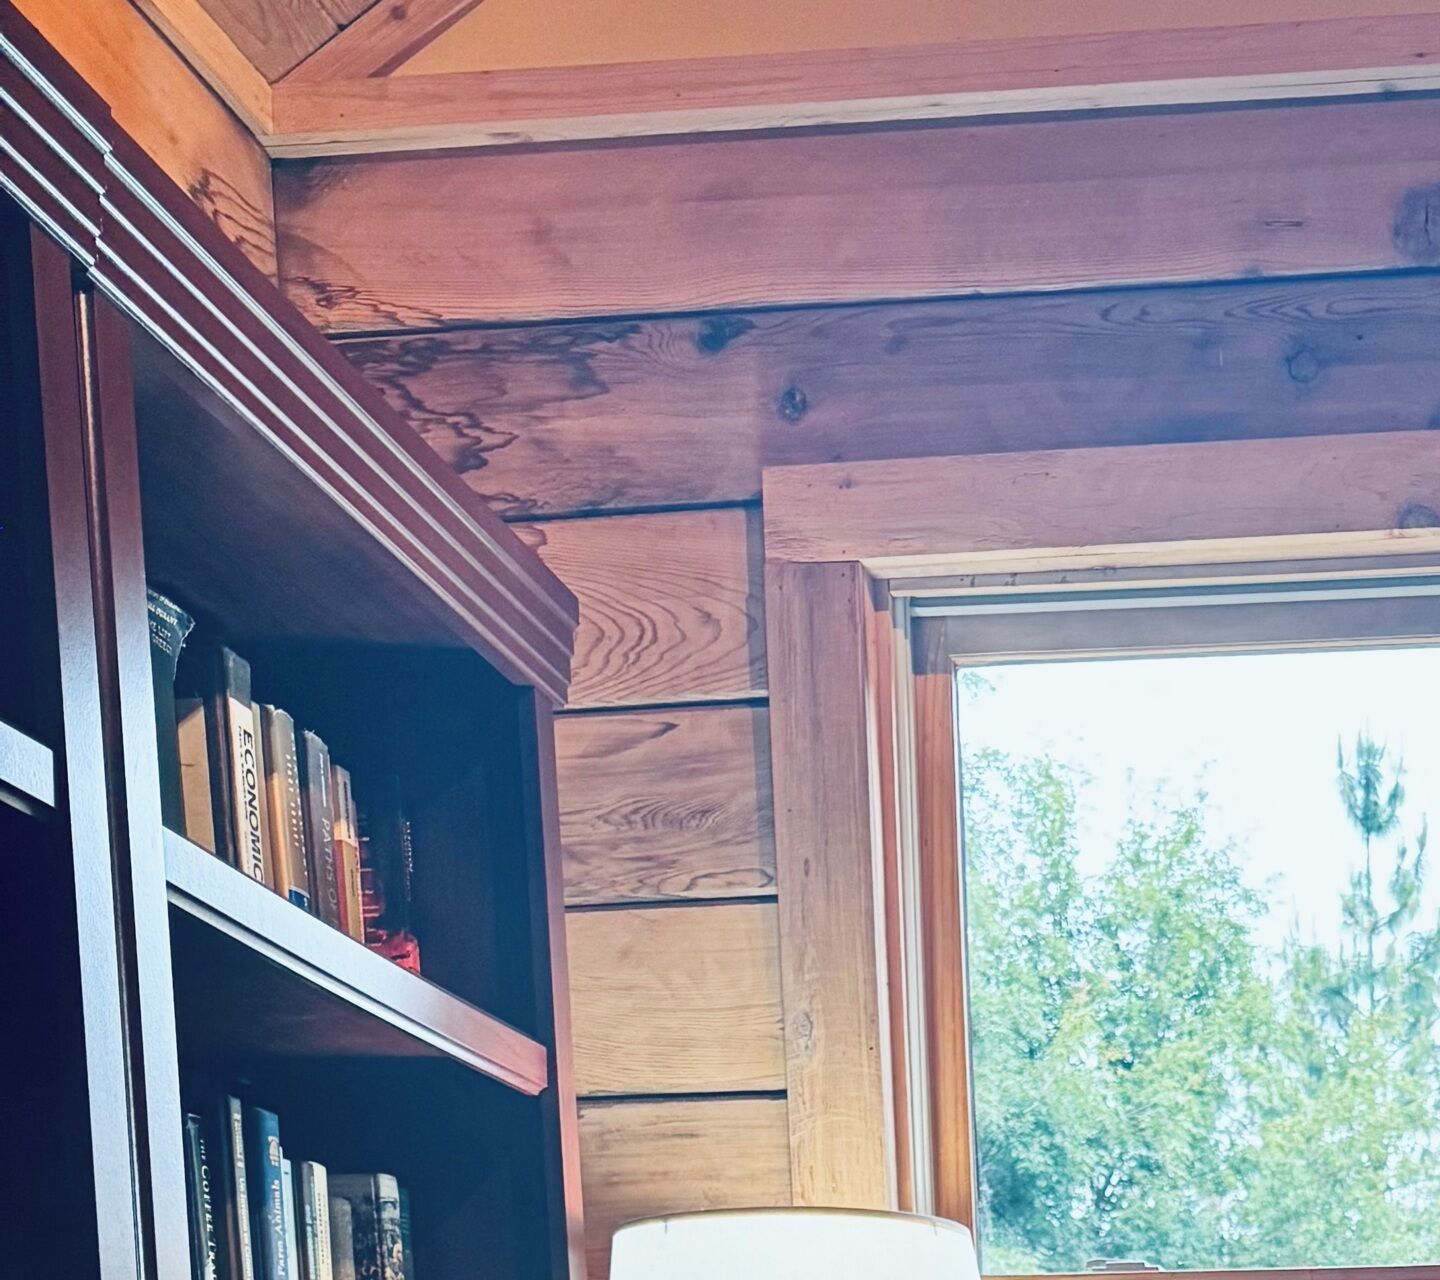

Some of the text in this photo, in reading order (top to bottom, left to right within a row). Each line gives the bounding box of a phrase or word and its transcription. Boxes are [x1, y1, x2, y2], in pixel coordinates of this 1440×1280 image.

[322, 817, 335, 881] PATHS
[202, 1164, 215, 1232] COFFEE
[272, 1179, 281, 1234] Animals
[277, 1240, 285, 1276] Farm
